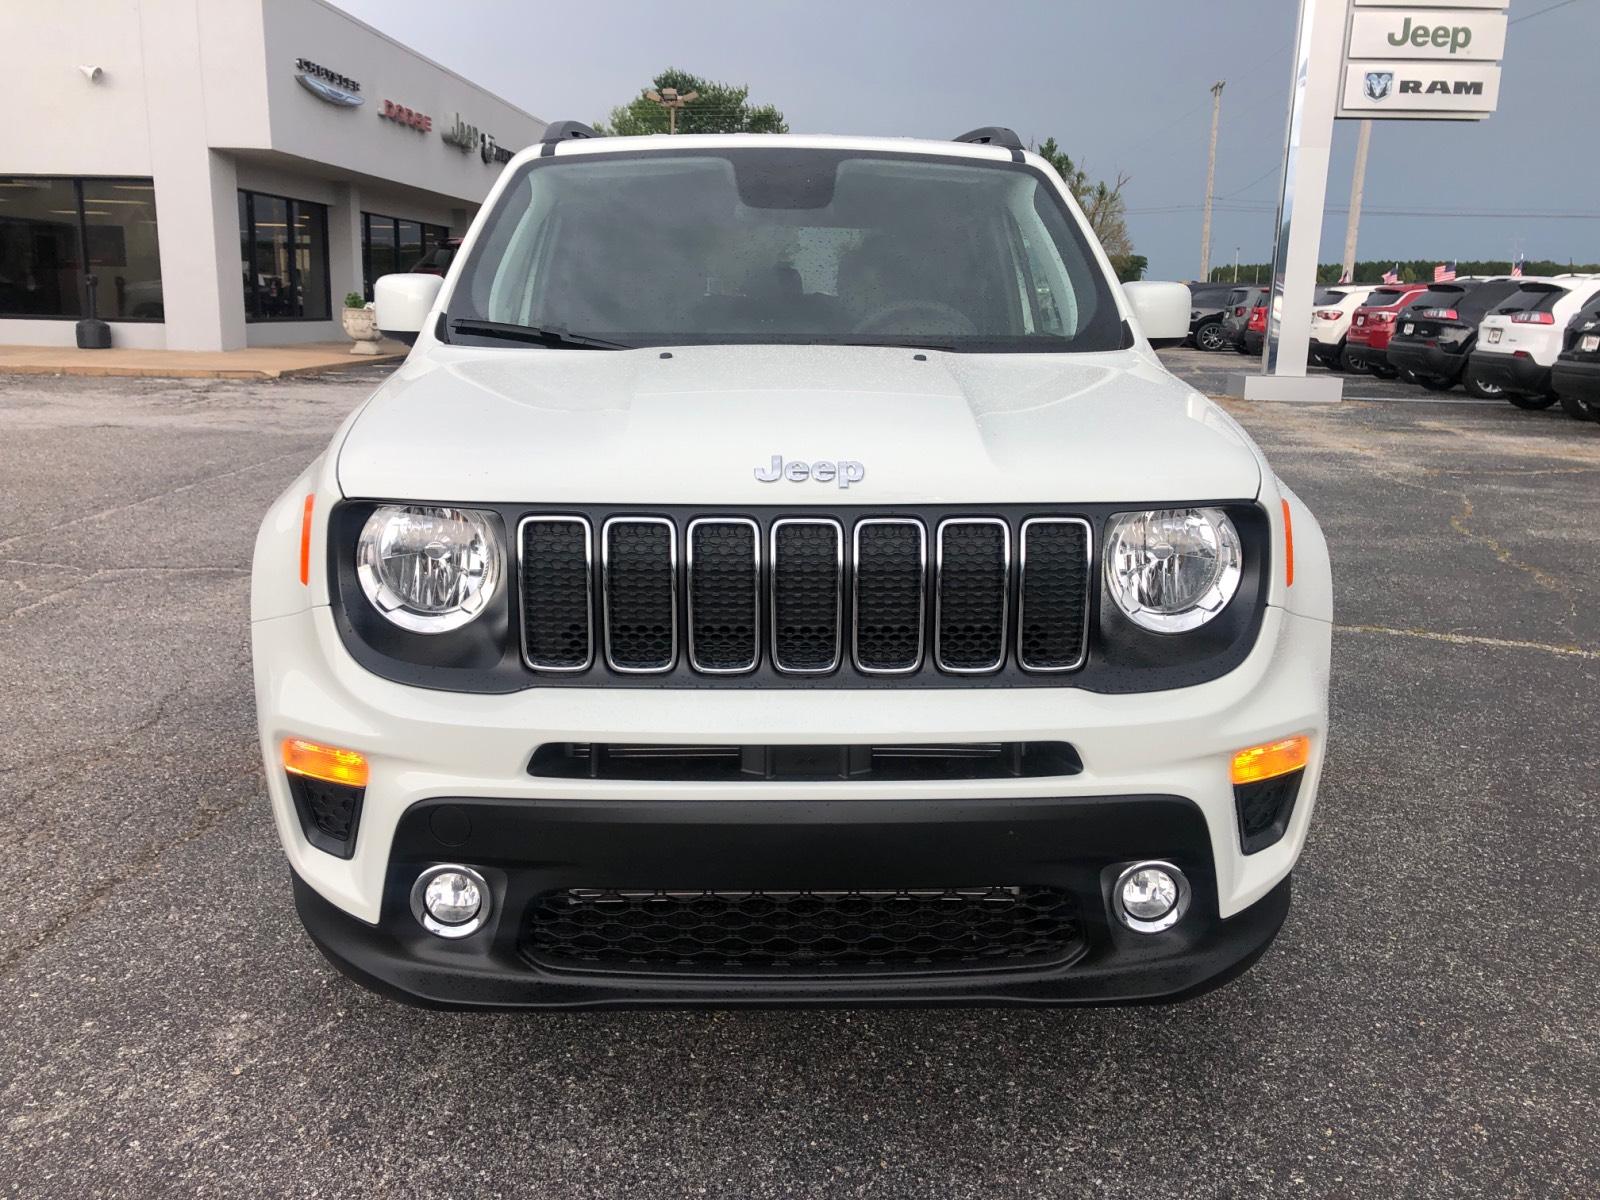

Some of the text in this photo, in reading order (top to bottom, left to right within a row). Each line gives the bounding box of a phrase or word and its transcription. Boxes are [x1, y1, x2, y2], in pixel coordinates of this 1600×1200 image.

[1387, 17, 1472, 54] Jeep
[1399, 80, 1483, 95] RAM
[754, 455, 865, 489] Jeep
